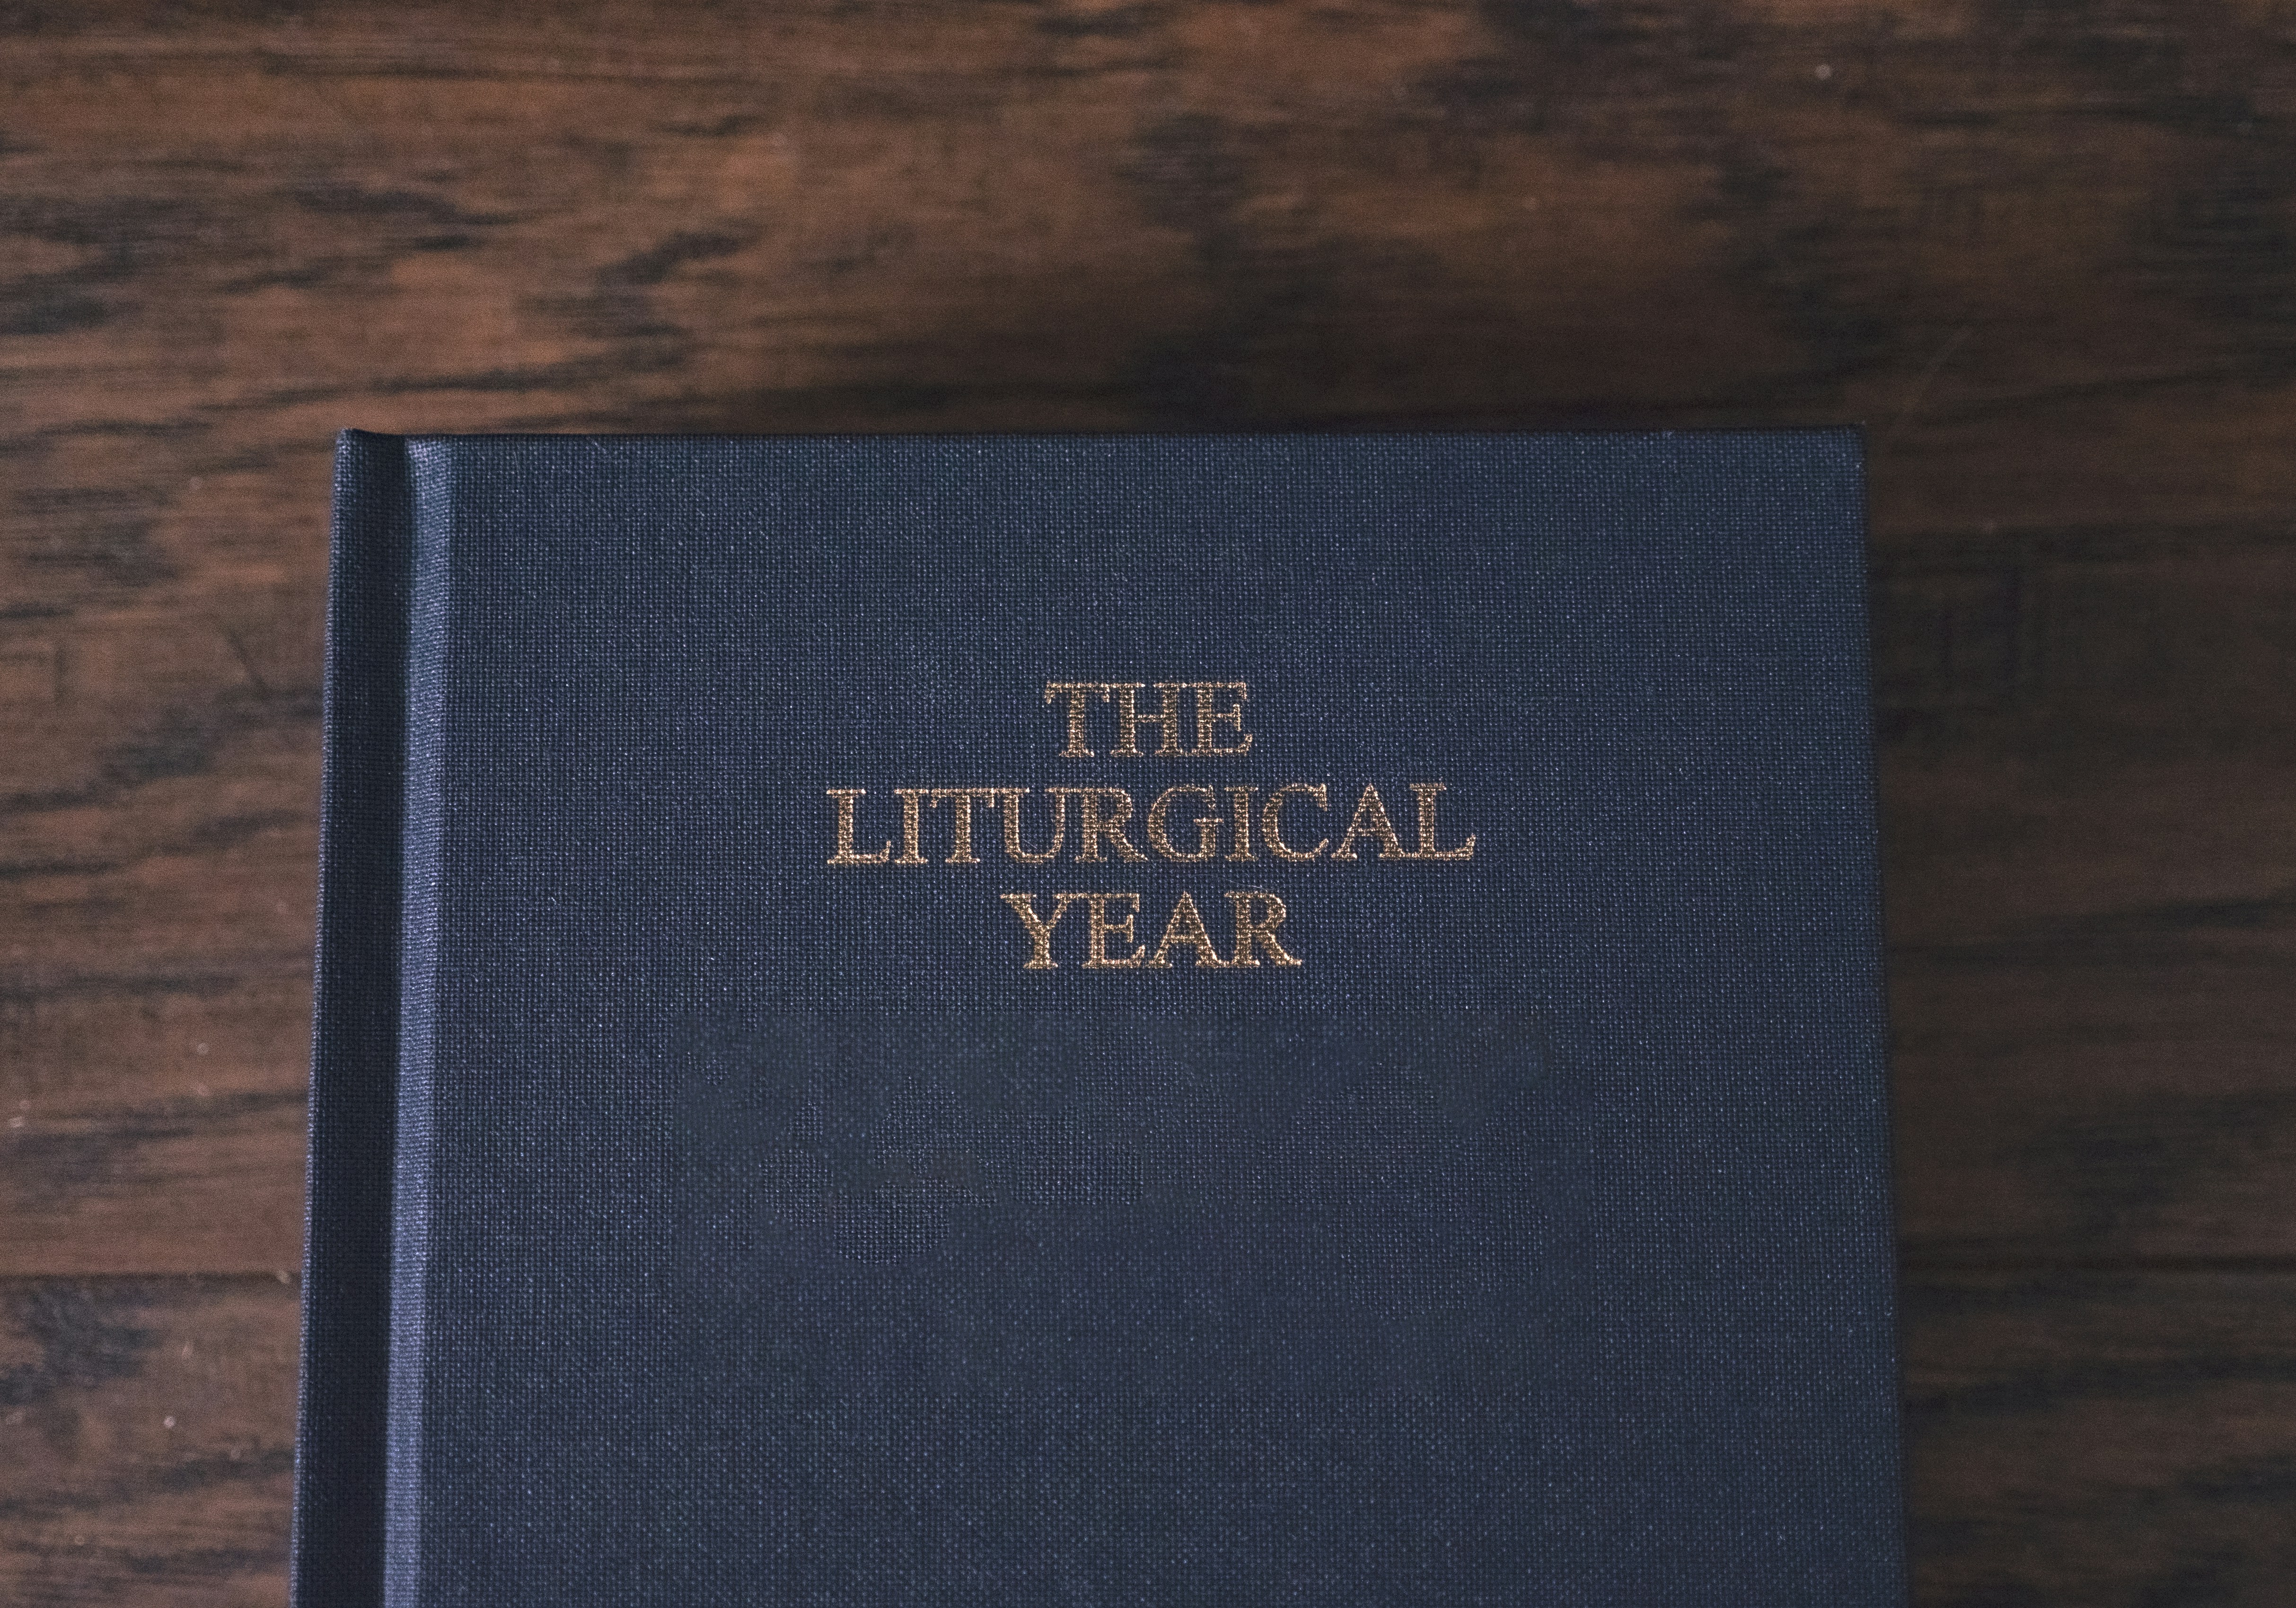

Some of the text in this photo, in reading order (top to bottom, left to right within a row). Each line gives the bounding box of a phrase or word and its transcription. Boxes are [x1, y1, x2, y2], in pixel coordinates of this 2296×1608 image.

[1045, 682, 1253, 757] THE
[827, 783, 1476, 865] LITURGICAL
[1000, 891, 1302, 969] YEAR
